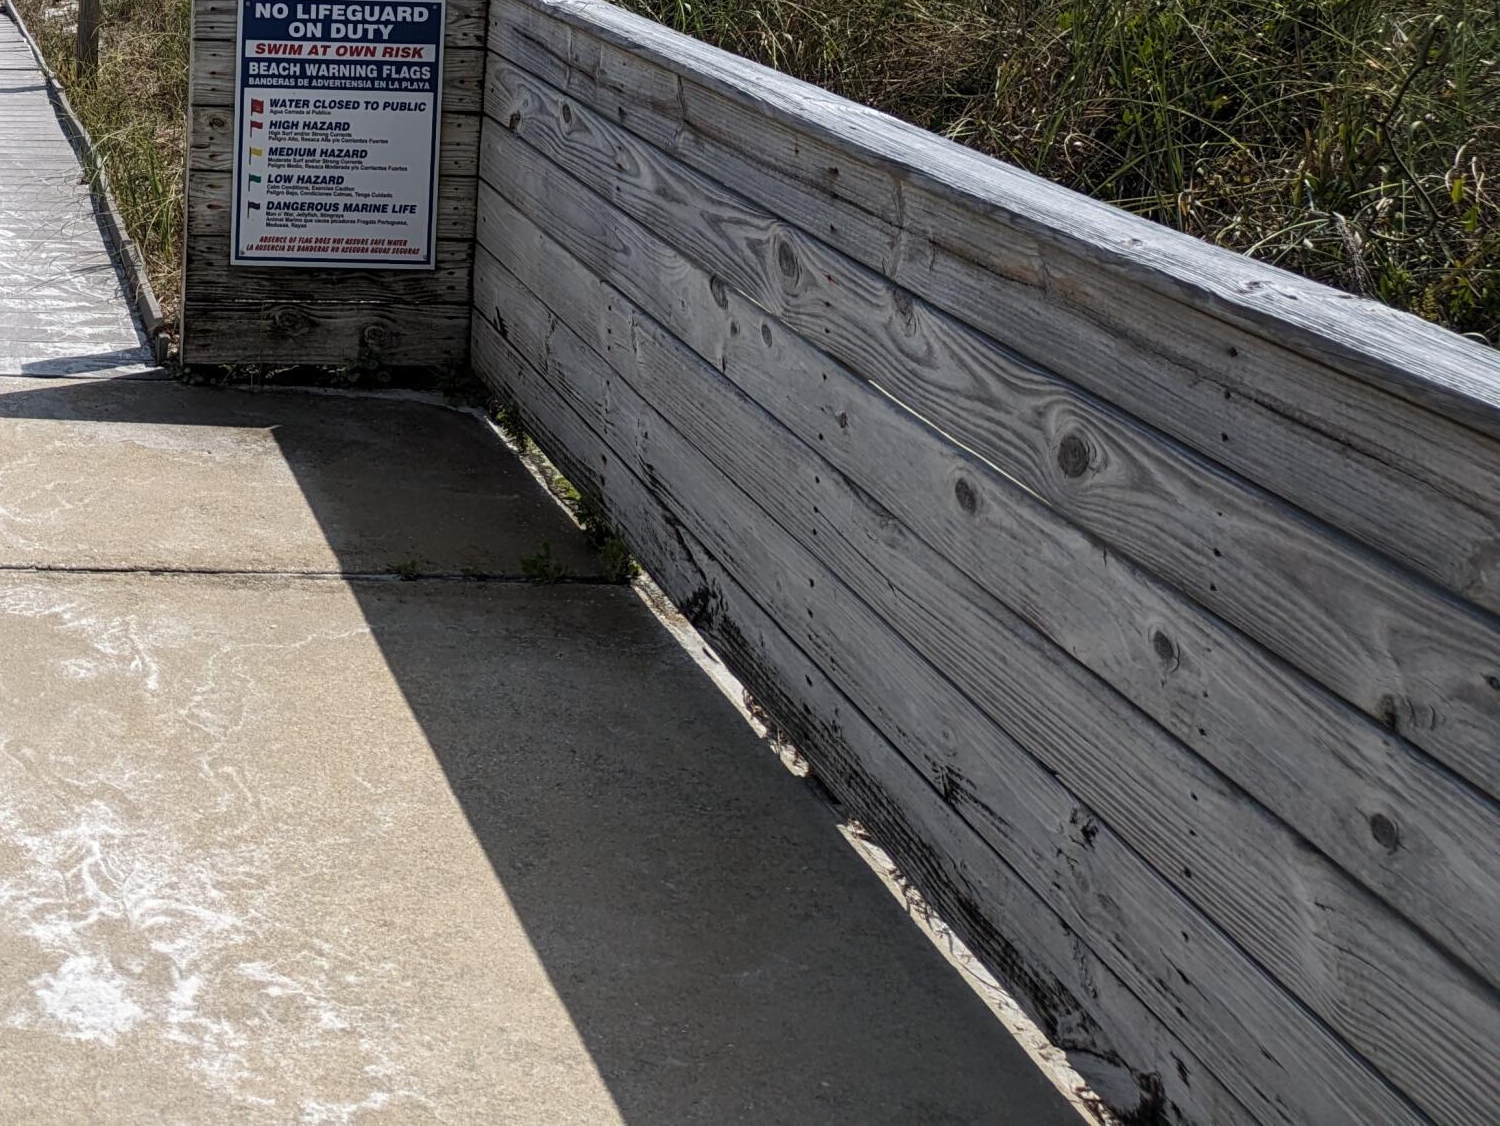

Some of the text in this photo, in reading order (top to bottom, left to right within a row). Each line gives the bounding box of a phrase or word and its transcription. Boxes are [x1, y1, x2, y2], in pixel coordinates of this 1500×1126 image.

[255, 3, 429, 22] NO LIFEGUARD
[289, 22, 394, 40] ON DUTY
[255, 43, 424, 59] SWIM AT OWN RISK
[249, 62, 431, 79] BEACH WARNING FLAGS
[248, 77, 430, 90] BANDERAS DE ADVERTENSIA EN LA PLAYA
[269, 98, 427, 112] WATER CLOSED TO PUBLIC
[269, 120, 350, 131] HIGH HAZARD
[268, 147, 368, 158] MEDIUM HAZARD
[267, 174, 344, 185] LOW HAZARD
[266, 201, 417, 214] DANGEROUS MARINE LIFE
